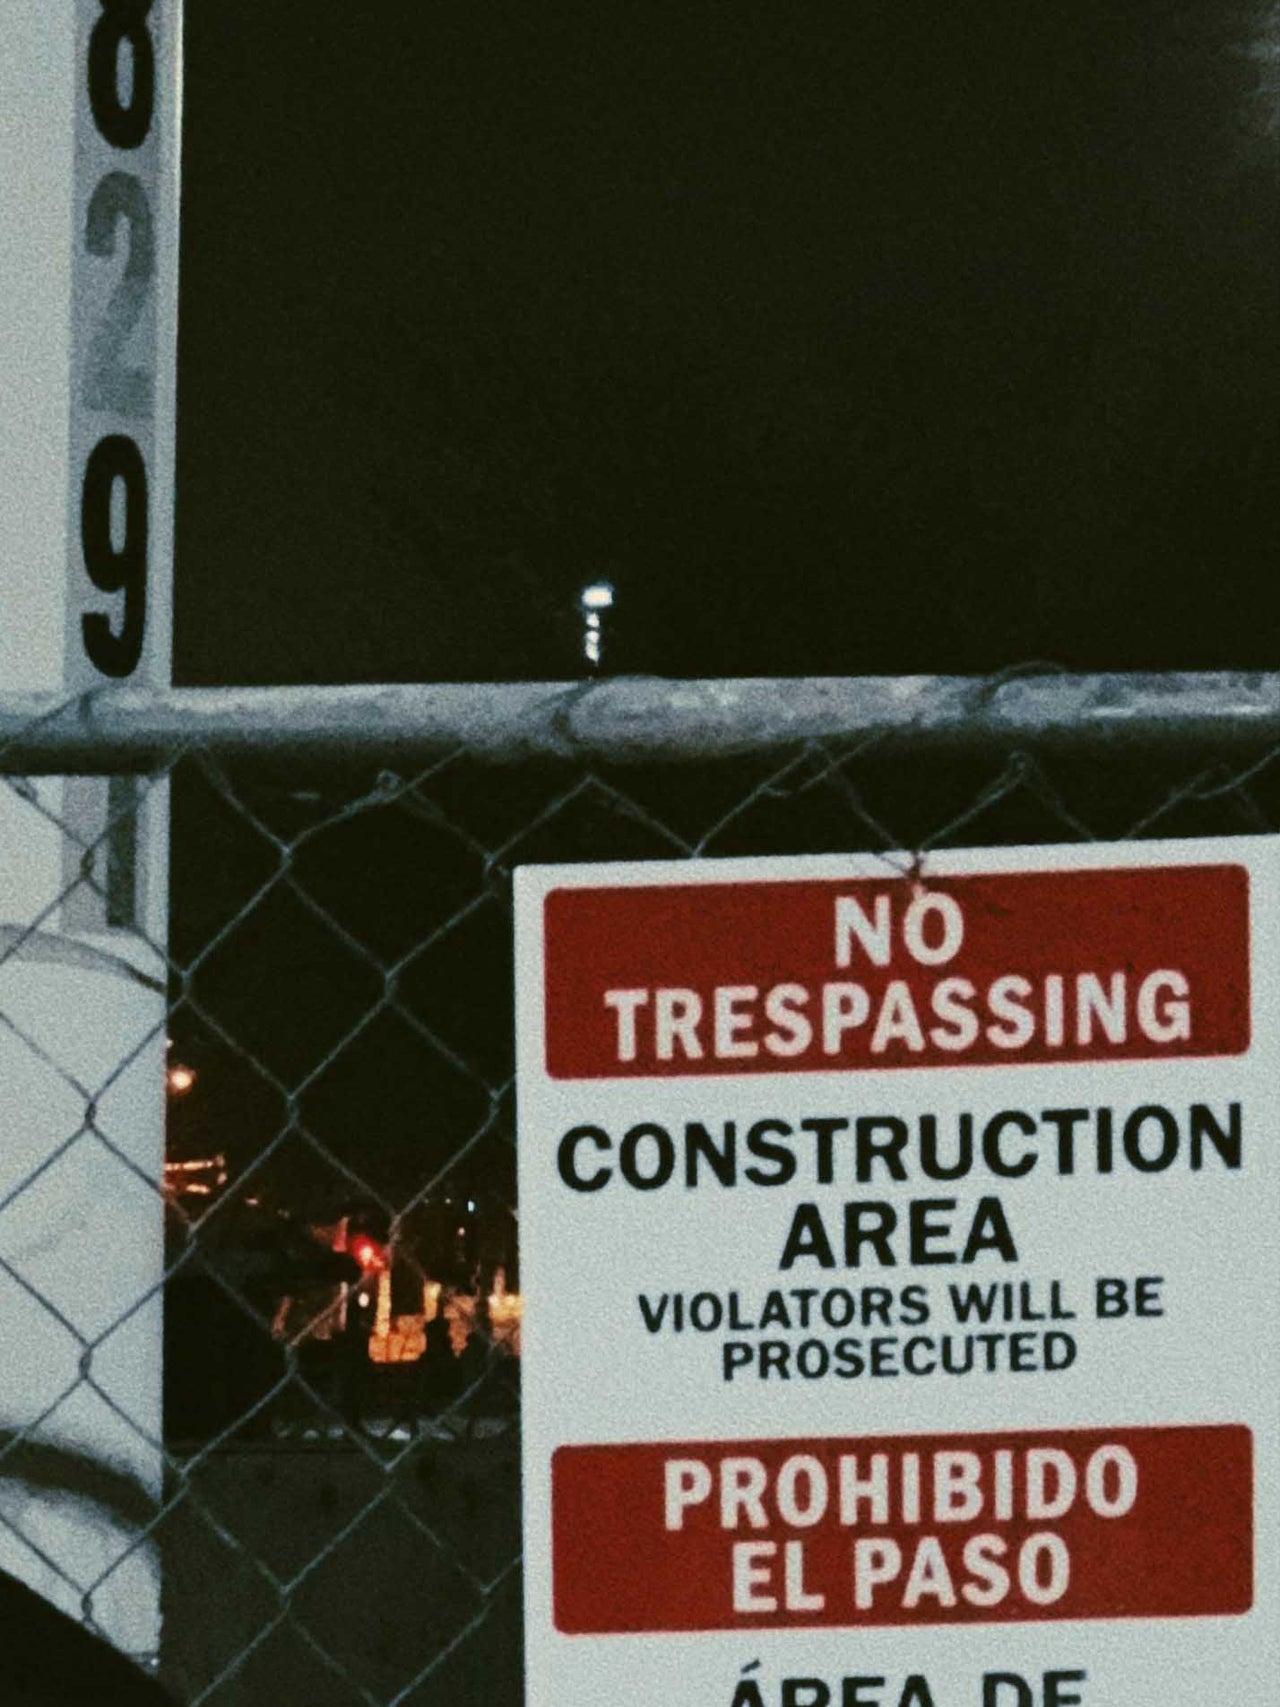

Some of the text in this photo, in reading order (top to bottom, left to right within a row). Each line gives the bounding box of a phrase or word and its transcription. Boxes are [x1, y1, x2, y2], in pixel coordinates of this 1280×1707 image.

[835, 892, 964, 968] NO
[604, 968, 1190, 1061] TRESPASSING
[557, 1102, 1242, 1192] CONSTRUCTION
[779, 1196, 1018, 1270] AREA
[638, 1276, 1164, 1333] VIOLATORS WILL BE
[722, 1331, 1078, 1381] PROSECUTED
[664, 1443, 1139, 1531] PROHIBIDO
[732, 1532, 1071, 1612] EL PASO
